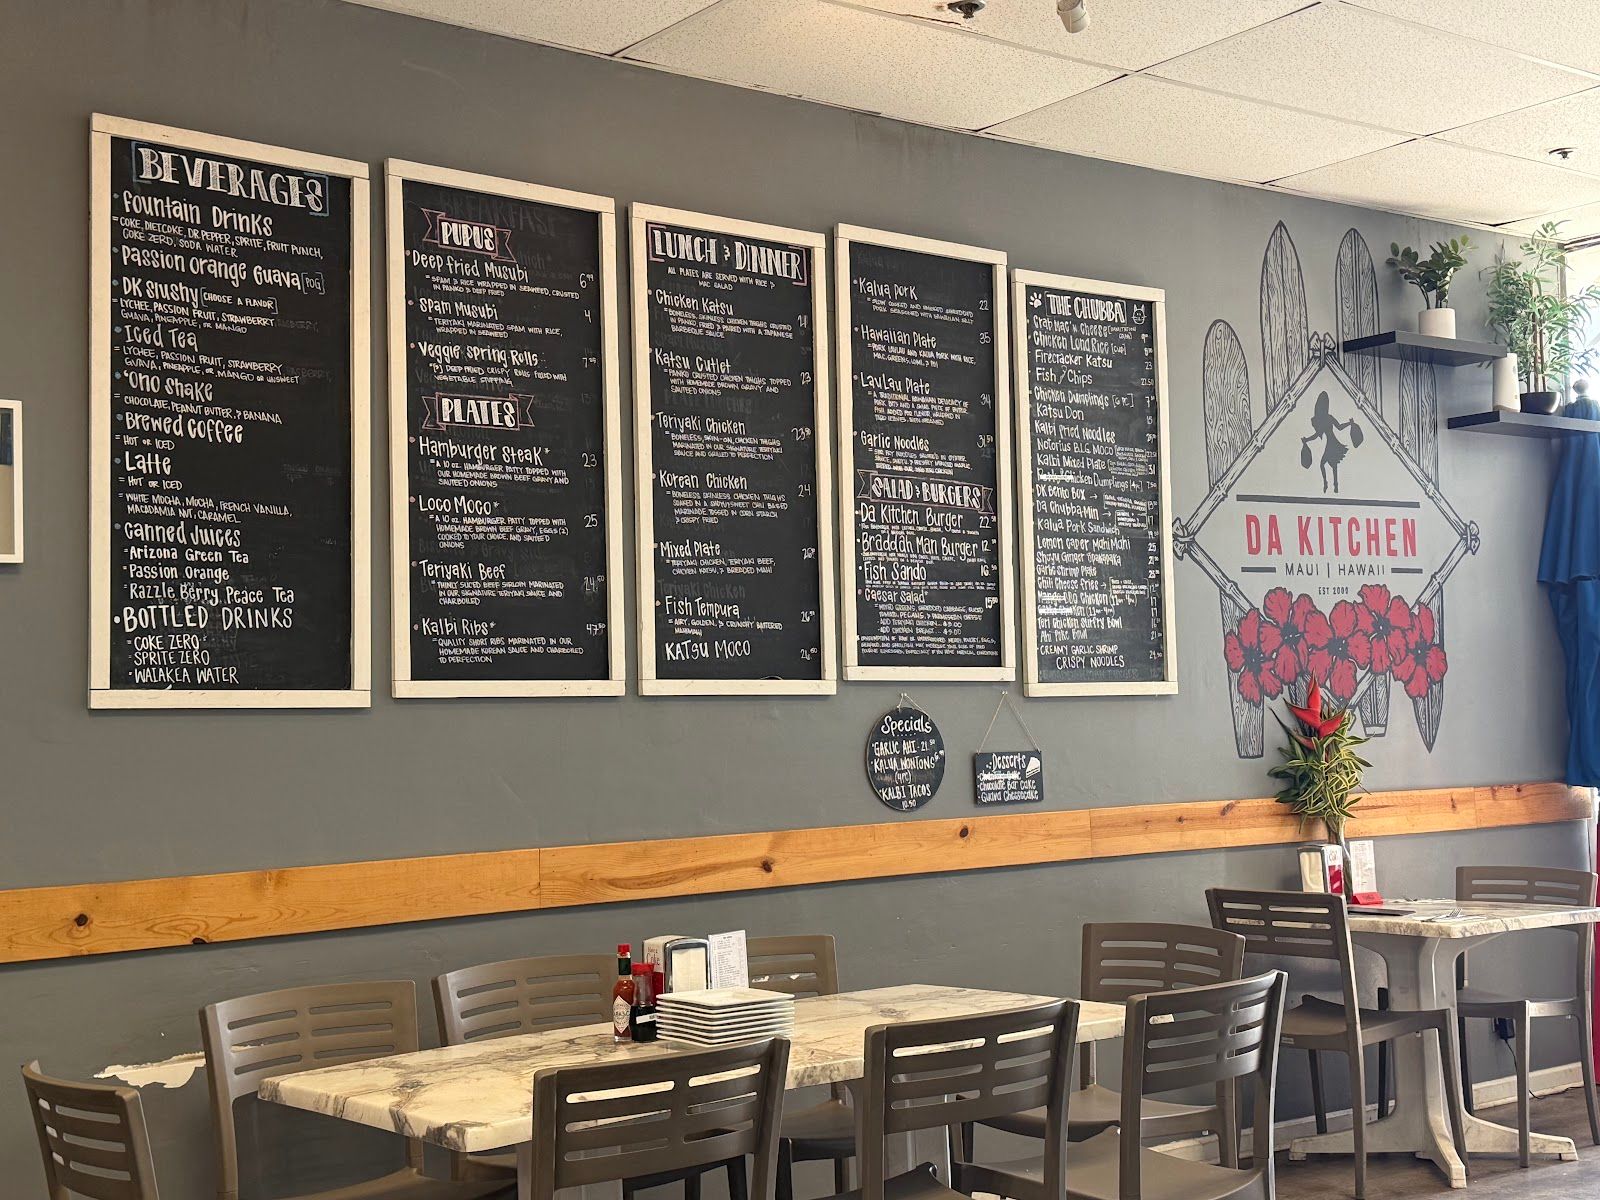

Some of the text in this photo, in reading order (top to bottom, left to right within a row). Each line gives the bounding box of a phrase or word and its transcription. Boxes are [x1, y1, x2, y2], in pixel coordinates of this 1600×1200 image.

[138, 147, 324, 212] BEVERAGES
[123, 229, 239, 258] COKE SODA WATER
[267, 240, 290, 253] FRUIT
[441, 221, 495, 251] PUPUS
[653, 229, 803, 281] LUNCH DINNER
[413, 250, 443, 273] Deep
[484, 261, 529, 283] Musubi
[123, 277, 143, 298] DK
[859, 277, 989, 311] Kalua 22
[153, 302, 190, 316] PASSION
[455, 303, 499, 321] Musubi
[655, 288, 734, 316] Chicken Katsu
[1047, 294, 1126, 324] THE CHUBBA
[124, 323, 198, 352] Iced Tea
[215, 323, 247, 334] MANGO
[861, 324, 991, 349] Hawaiian Plate 35
[1033, 330, 1068, 352] Chicken
[161, 351, 283, 374] PASSION STRAWBERRY
[418, 341, 539, 368] Veggie Rolls
[1035, 349, 1113, 369] Firecracker Katsu
[218, 369, 254, 382] MANGO
[655, 348, 812, 385] Katsu Cutlet 23
[905, 377, 930, 395] Plate
[1036, 367, 1093, 388] Fish Chips
[1034, 385, 1109, 410] Chicken Dumplings
[171, 401, 283, 425] PEANUT BANANA
[442, 398, 516, 428] PLATES
[1036, 403, 1085, 421] Katsu Don
[125, 412, 184, 438] Brewed
[656, 411, 746, 436] Teriyaki Chicken
[124, 435, 175, 451] HOT ICED
[860, 430, 930, 452] Garlic Noodles
[1082, 427, 1116, 444] Noodles
[419, 435, 497, 466] Hamburger
[582, 453, 598, 468] 23
[125, 451, 172, 476] Latte
[128, 476, 183, 491] HOT ICED
[514, 474, 531, 483] BEEF
[659, 469, 811, 498] Korean Chicken 24
[126, 493, 251, 513] WHITE FRENCH
[871, 477, 981, 509] SALAD BURGERS
[127, 505, 241, 524] MACADAMIA CARAMEL
[584, 514, 598, 528] 25
[861, 502, 876, 523] Da
[881, 504, 920, 526] Kitchen
[925, 507, 964, 532] Burger
[1037, 518, 1064, 531] Kalua
[1087, 521, 1120, 536] Sandwich
[1245, 514, 1417, 557] DA KITCHEN
[660, 539, 721, 558] Mixed Plate
[862, 532, 914, 554] Braddah
[916, 535, 938, 556] Man
[941, 537, 978, 561] Burger
[1037, 535, 1064, 550] Lemon
[129, 545, 249, 564] Arizona Green Tea
[129, 562, 178, 580] Passion
[419, 559, 506, 581] Teriyaki Beef
[864, 561, 927, 581] Fish Sando
[1285, 562, 1385, 577] MAUI HAWAII
[130, 582, 295, 607] Razzle Berry Peace Tea
[1318, 586, 1330, 596] EST
[665, 595, 740, 620] Fish Tempura
[123, 605, 293, 633] BOTTLED DRINKS
[422, 617, 458, 637] Kalbi
[134, 634, 200, 651] COKE ZERO
[1040, 645, 1119, 657] CREAMY GARLIC SHRIMP
[134, 650, 210, 666] SPRITE ZERO
[448, 655, 493, 664] PERFECTION
[1056, 655, 1125, 670] CRISPY NOODLES
[196, 667, 240, 684] WATER
[880, 715, 933, 737] Specials
[873, 741, 916, 756] GARLIC AHI
[900, 755, 935, 771] WONTONS
[907, 783, 932, 798] TACOS
